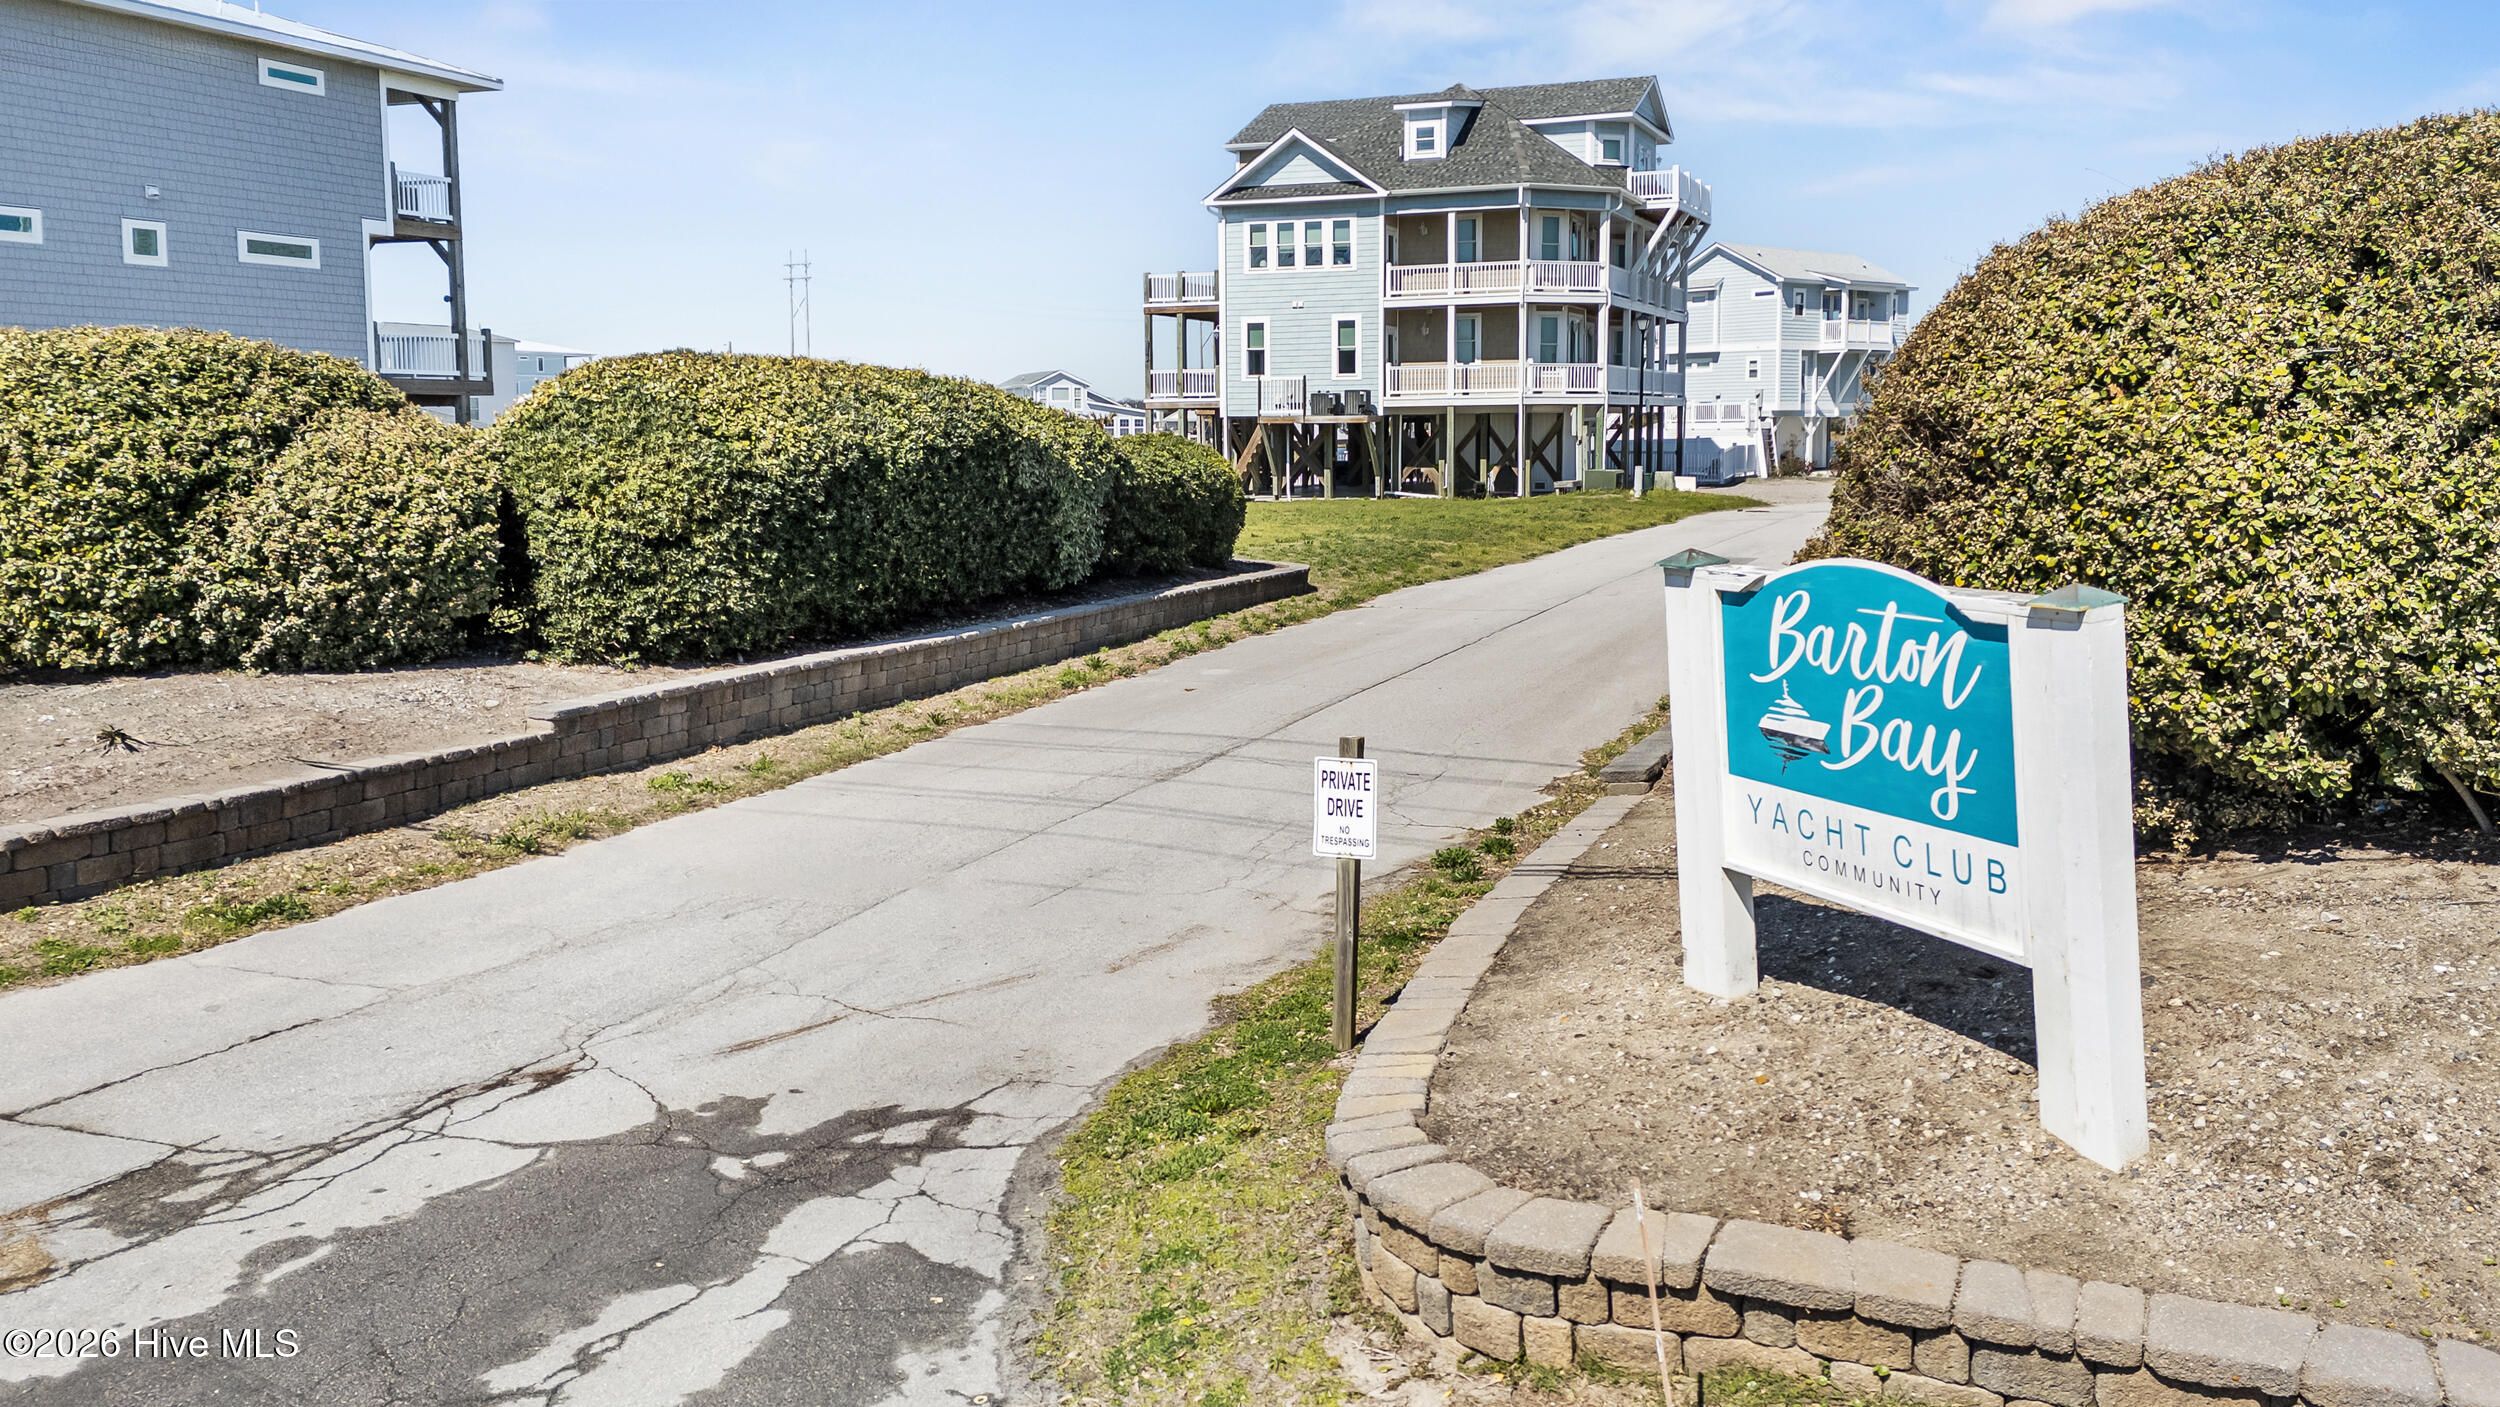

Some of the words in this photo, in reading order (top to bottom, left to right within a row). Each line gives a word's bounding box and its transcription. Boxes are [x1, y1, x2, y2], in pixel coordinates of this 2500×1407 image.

[1749, 590, 1982, 710] Barton
[1820, 684, 1978, 821] Bay
[1321, 770, 1371, 791] PRIVATE
[1327, 797, 1363, 818] DRIVE
[1321, 835, 1370, 848] TRESPASSING
[1339, 825, 1350, 835] NO
[1747, 793, 1871, 856] YACHT
[1893, 835, 2007, 895] CLUB
[1803, 850, 1942, 905] COMMUNITY
